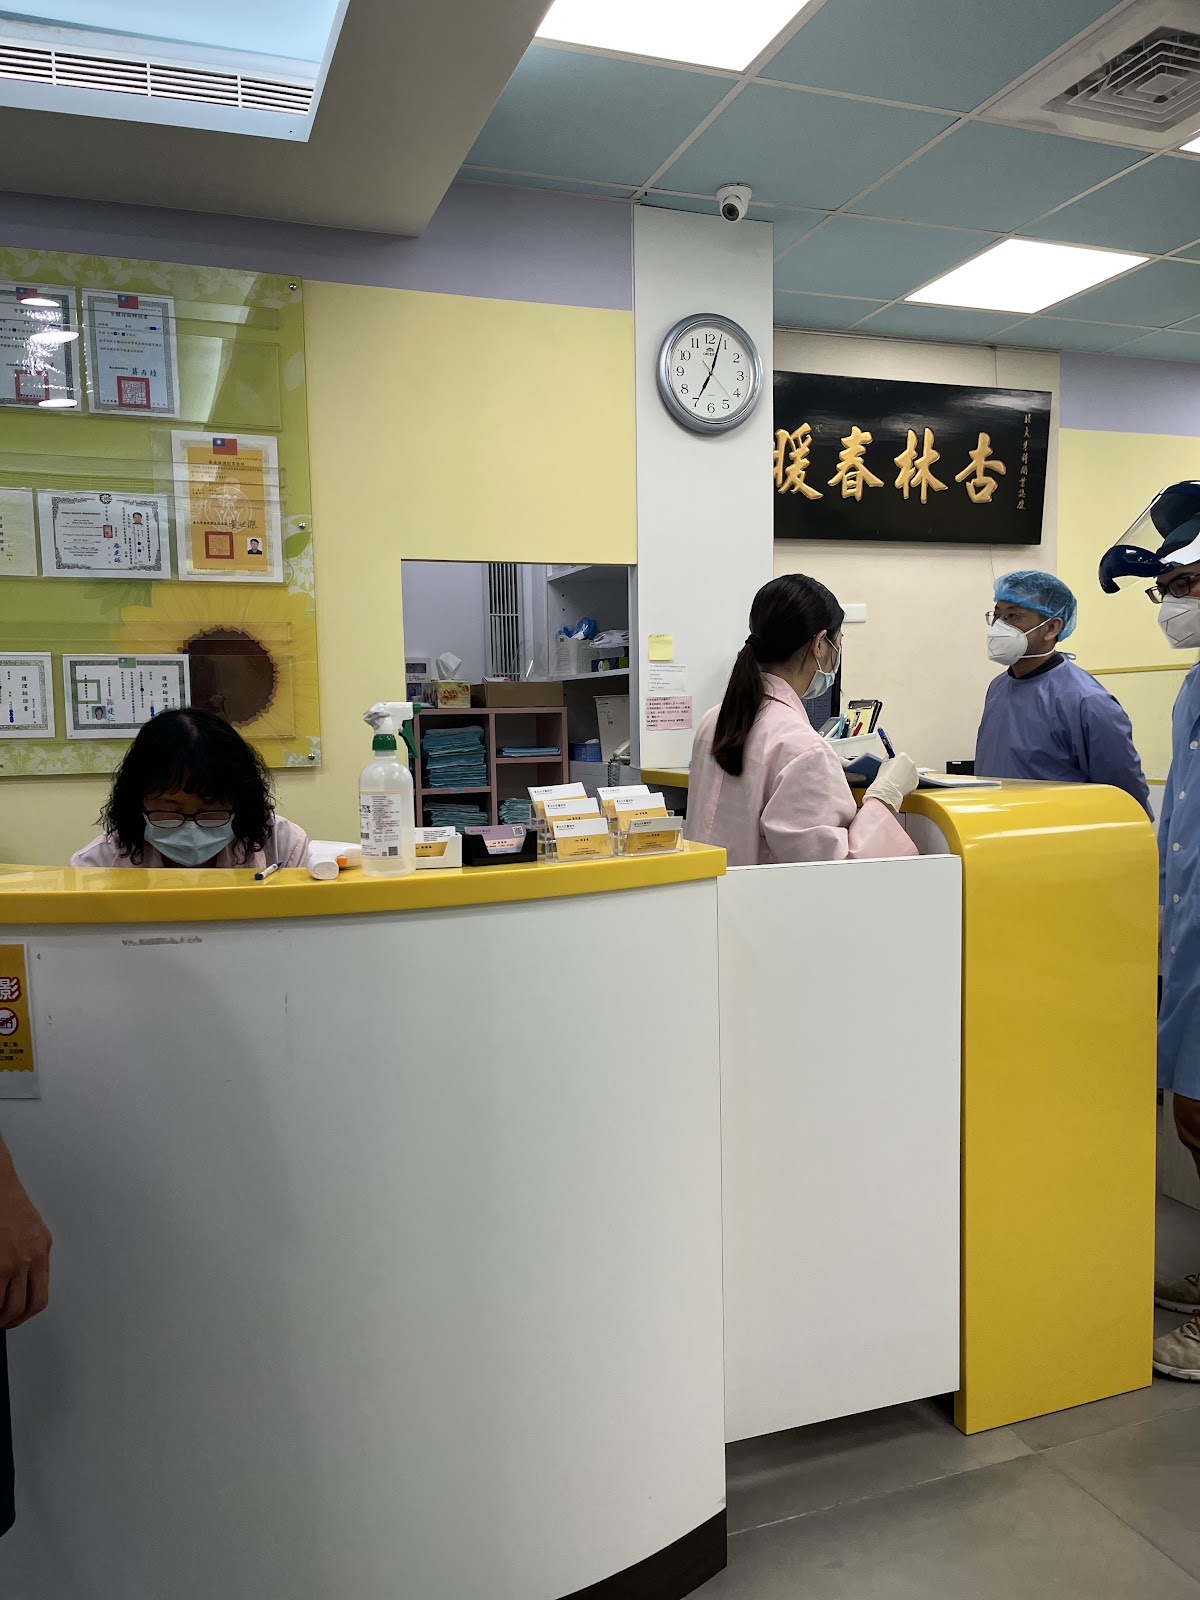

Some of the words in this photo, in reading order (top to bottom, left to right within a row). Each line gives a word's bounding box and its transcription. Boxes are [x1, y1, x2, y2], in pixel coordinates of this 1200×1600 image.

[691, 338, 699, 349] 11
[704, 333, 716, 345] 12
[723, 339, 727, 350] 1
[680, 349, 691, 361] 10
[732, 352, 740, 363] 2
[676, 366, 685, 376] 9
[736, 370, 745, 381] 3
[680, 384, 689, 394] 8
[733, 388, 741, 398] 4
[692, 397, 700, 408] 7
[722, 399, 730, 409] 5
[707, 403, 716, 414] 6
[0, 977, 20, 1001] 影
